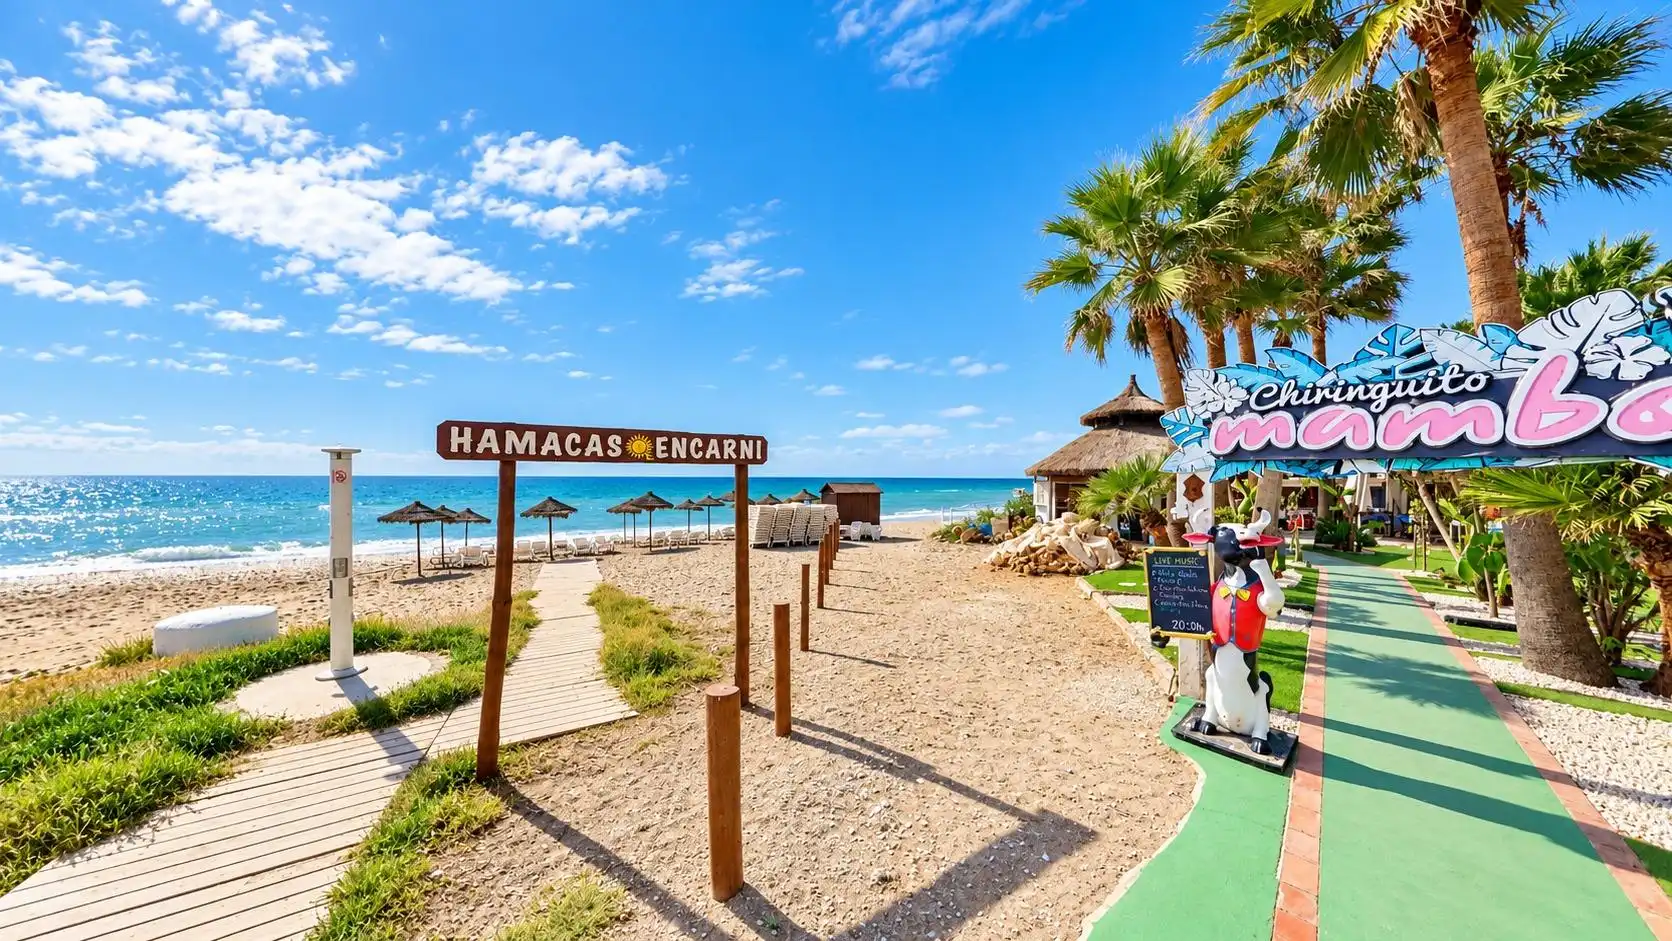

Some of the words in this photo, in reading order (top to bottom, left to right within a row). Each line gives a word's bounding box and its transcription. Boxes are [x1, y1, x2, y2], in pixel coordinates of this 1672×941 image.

[1249, 364, 1489, 412] Chiringuito
[450, 426, 622, 458] HAMACAS
[655, 437, 762, 460] ENCARNI
[1154, 557, 1171, 565] LIVE
